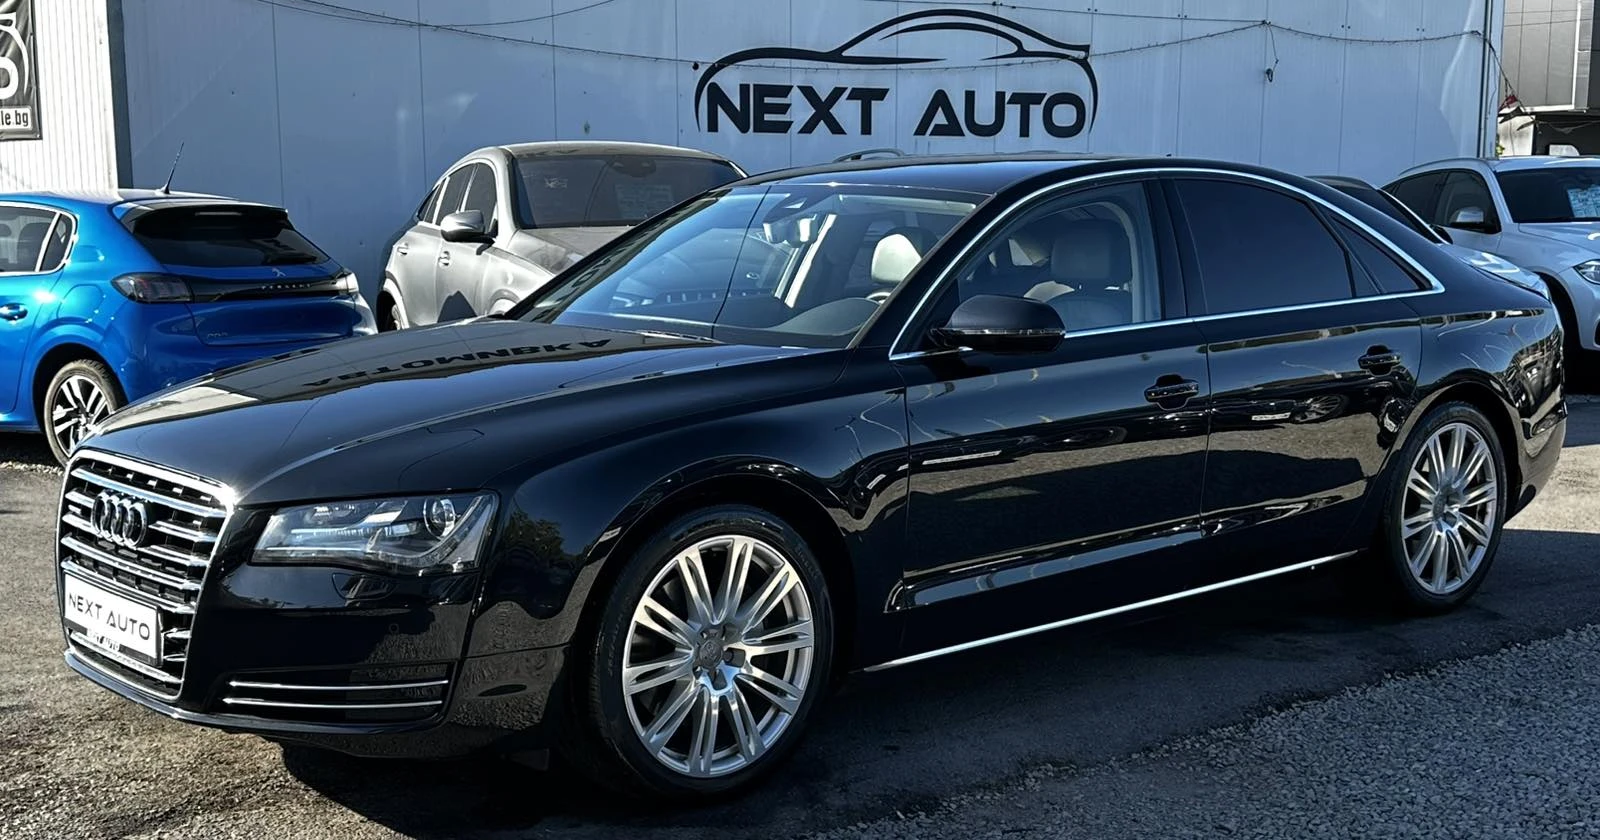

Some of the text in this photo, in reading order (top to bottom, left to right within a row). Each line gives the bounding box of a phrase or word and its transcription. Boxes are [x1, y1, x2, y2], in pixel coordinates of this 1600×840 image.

[706, 82, 1086, 138] NEXT AUTO
[69, 593, 102, 619] NEXT
[106, 610, 150, 640] AUTO
